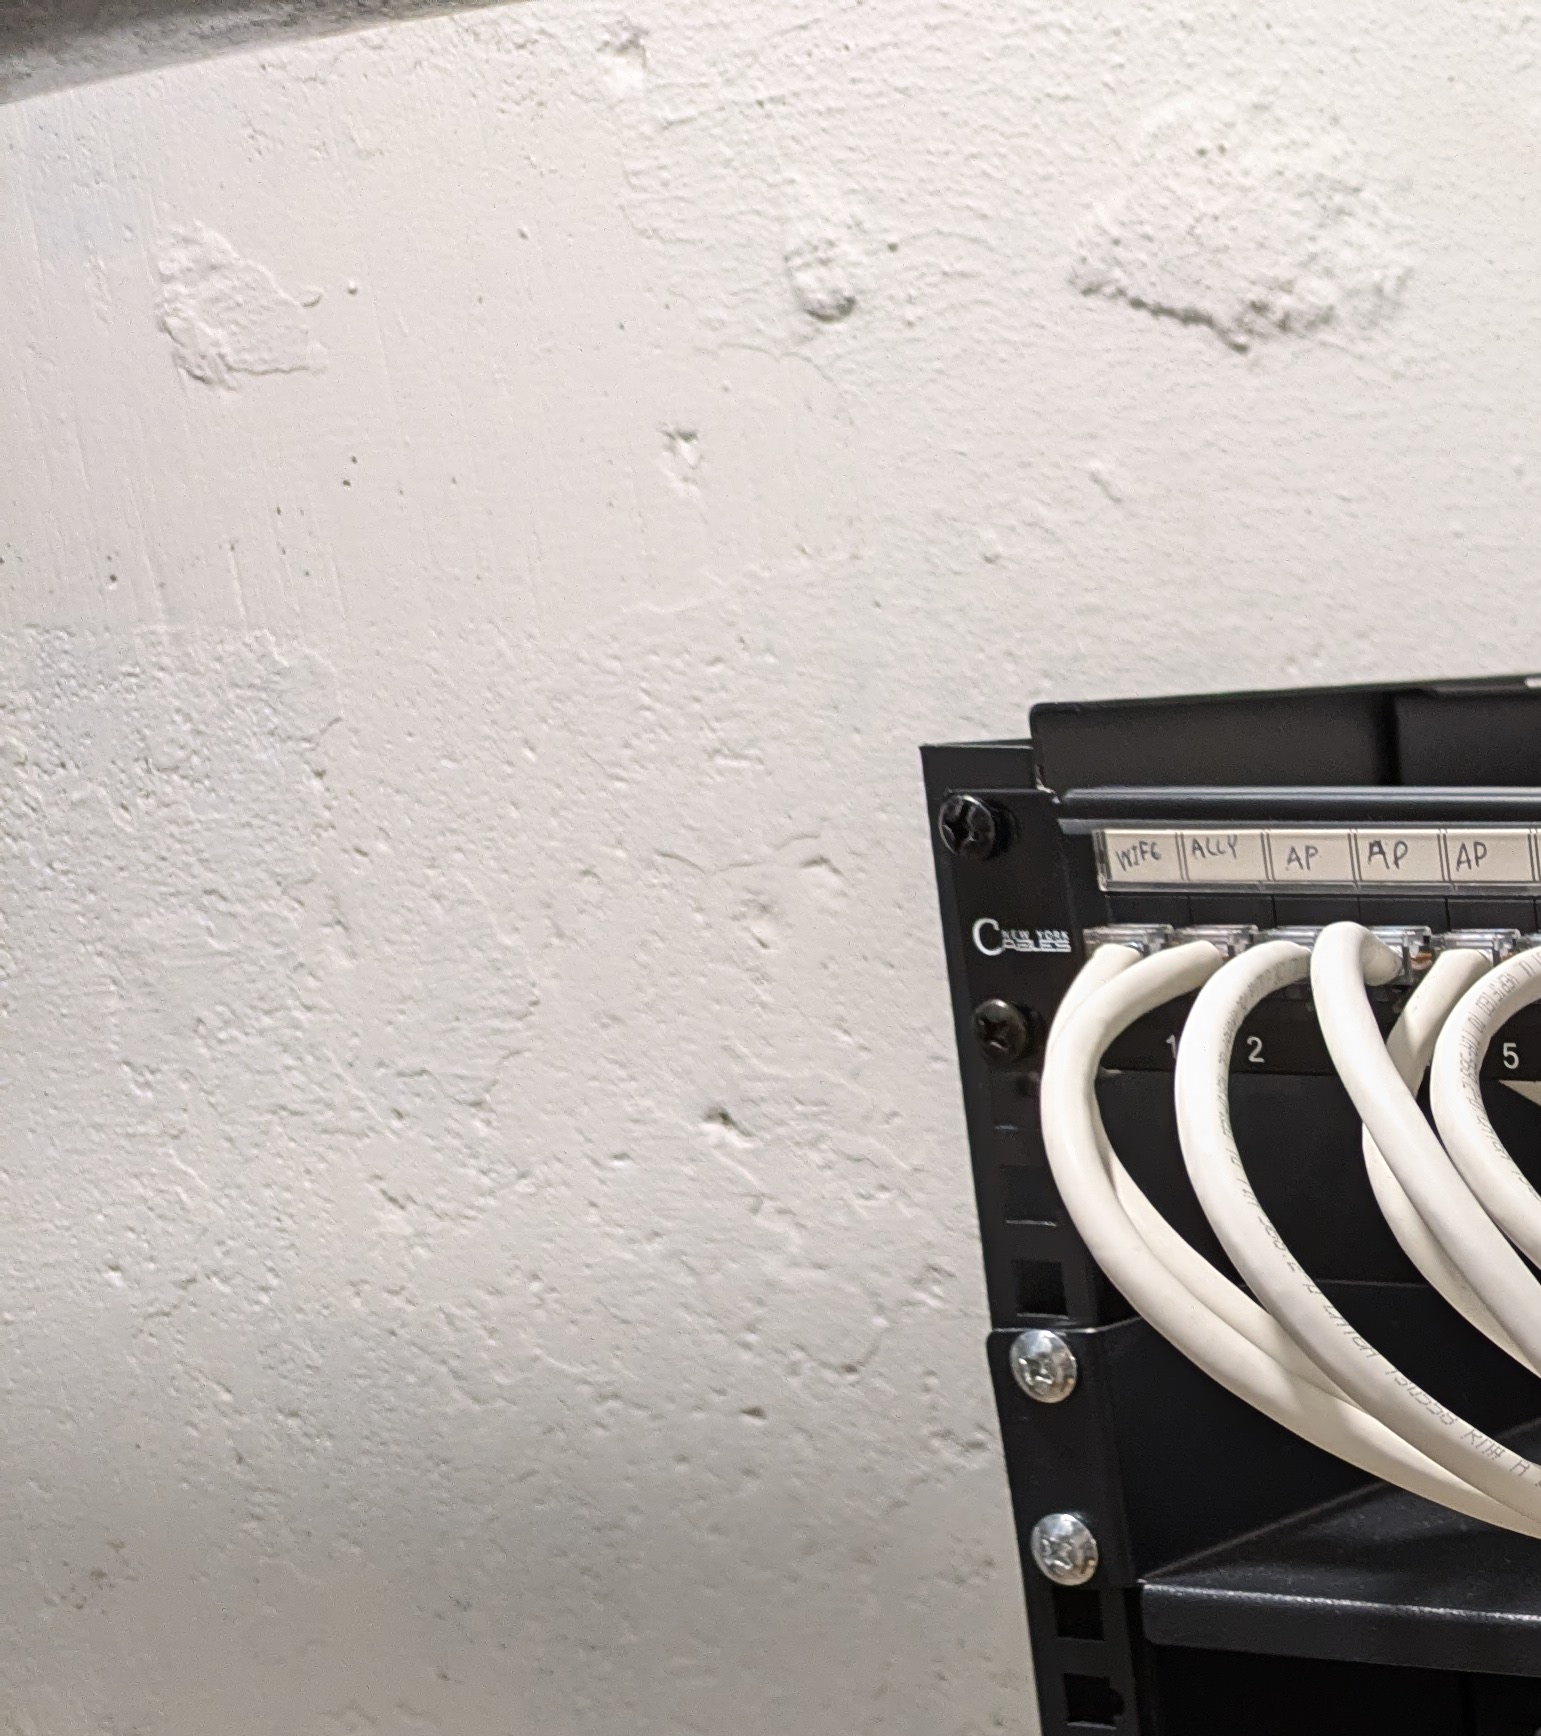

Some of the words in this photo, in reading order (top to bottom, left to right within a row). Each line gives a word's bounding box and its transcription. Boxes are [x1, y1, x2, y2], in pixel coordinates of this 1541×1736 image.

[1191, 834, 1238, 860] ALLY
[1285, 845, 1319, 871] AP
[1367, 840, 1409, 870] AP
[1456, 841, 1488, 871] AP
[1471, 968, 1521, 1018] VERIFIED
[1462, 1011, 1489, 1034] TO
[1247, 1037, 1264, 1062] 2
[1503, 1043, 1519, 1069] 5
